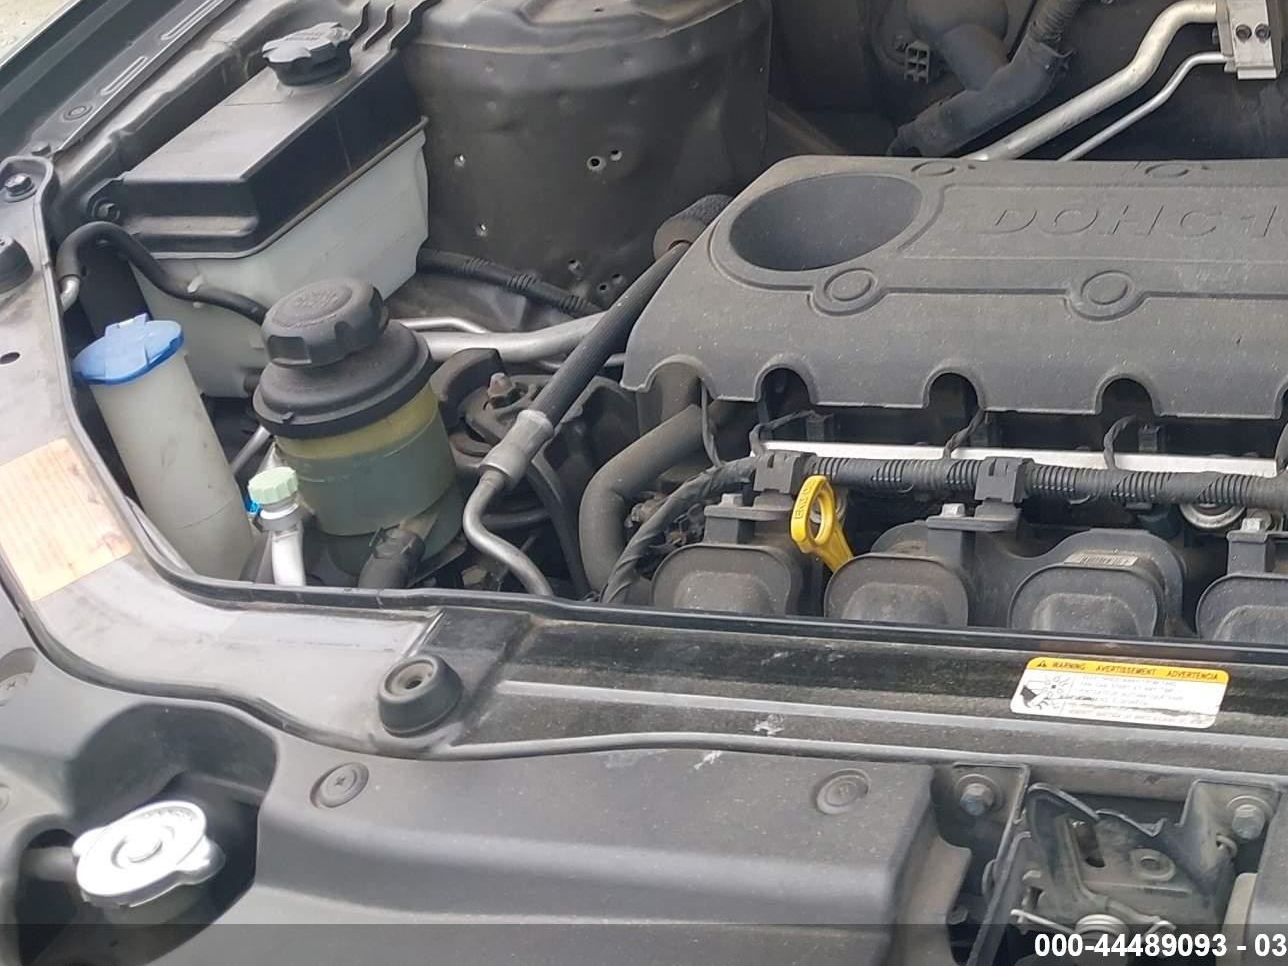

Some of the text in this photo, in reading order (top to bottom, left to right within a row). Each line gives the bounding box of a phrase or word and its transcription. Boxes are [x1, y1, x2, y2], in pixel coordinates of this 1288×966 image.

[980, 206, 1222, 238] DOHC
[1052, 662, 1218, 681] WARNING AVERTISSEMENT ADVERTENCIA
